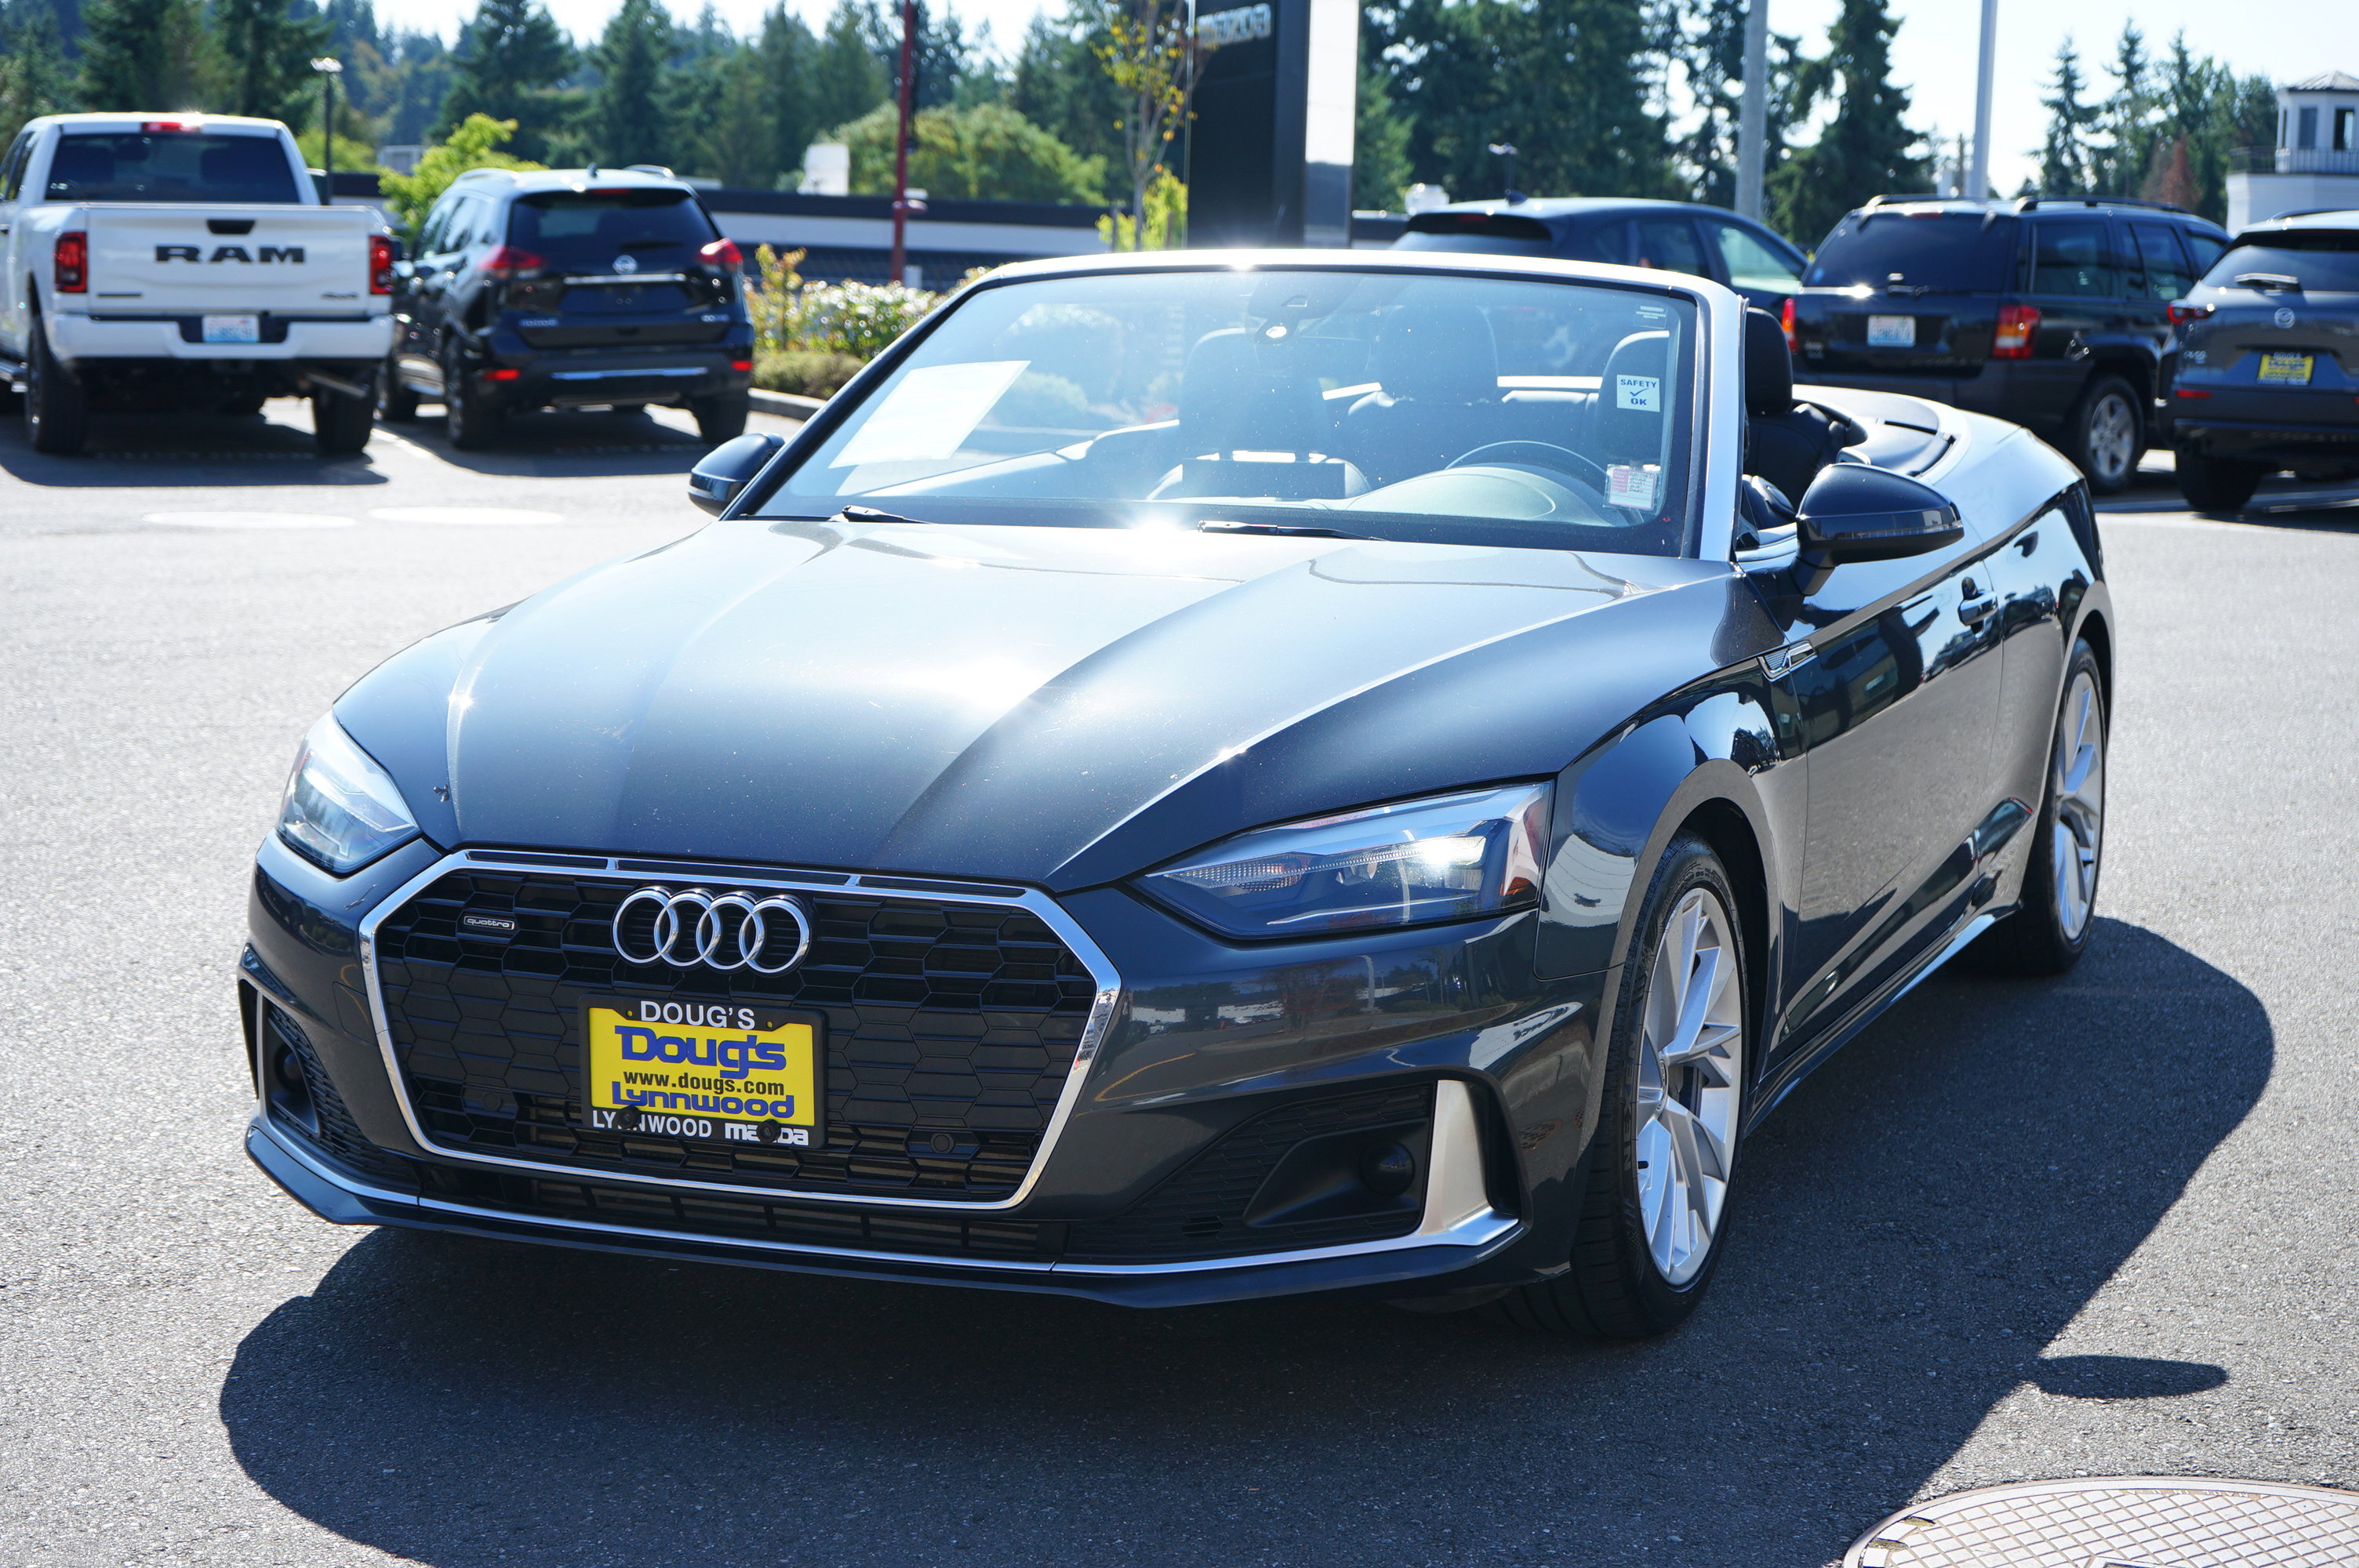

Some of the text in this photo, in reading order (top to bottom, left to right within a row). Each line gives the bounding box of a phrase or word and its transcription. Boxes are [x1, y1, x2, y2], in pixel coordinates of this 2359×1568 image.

[155, 245, 304, 262] RAM
[1620, 379, 1656, 387] SAFETY
[467, 918, 510, 928] quattro
[640, 1000, 756, 1030] DOUG'S
[615, 1025, 787, 1080] Doug's
[623, 1071, 784, 1095] www.dougs.com
[612, 1081, 794, 1119] Lynnwood
[592, 1109, 809, 1146] LYNWOOD mada
